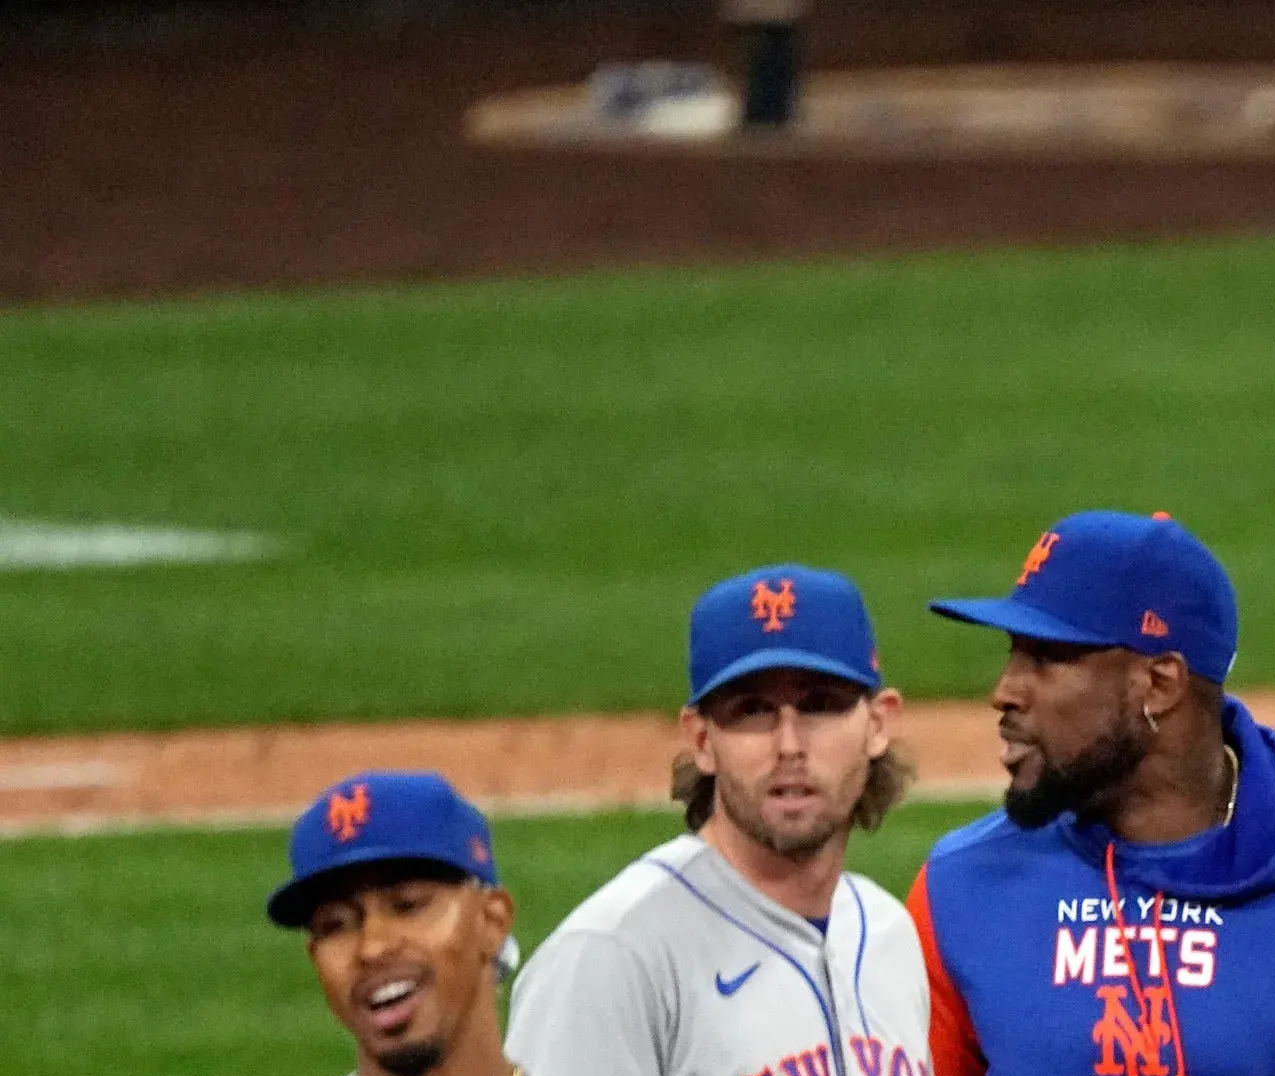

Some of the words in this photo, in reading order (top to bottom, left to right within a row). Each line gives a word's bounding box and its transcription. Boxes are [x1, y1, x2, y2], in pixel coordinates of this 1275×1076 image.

[1057, 897, 1127, 922] NEW
[1136, 895, 1224, 927] YORK
[1052, 925, 1218, 988] METS
